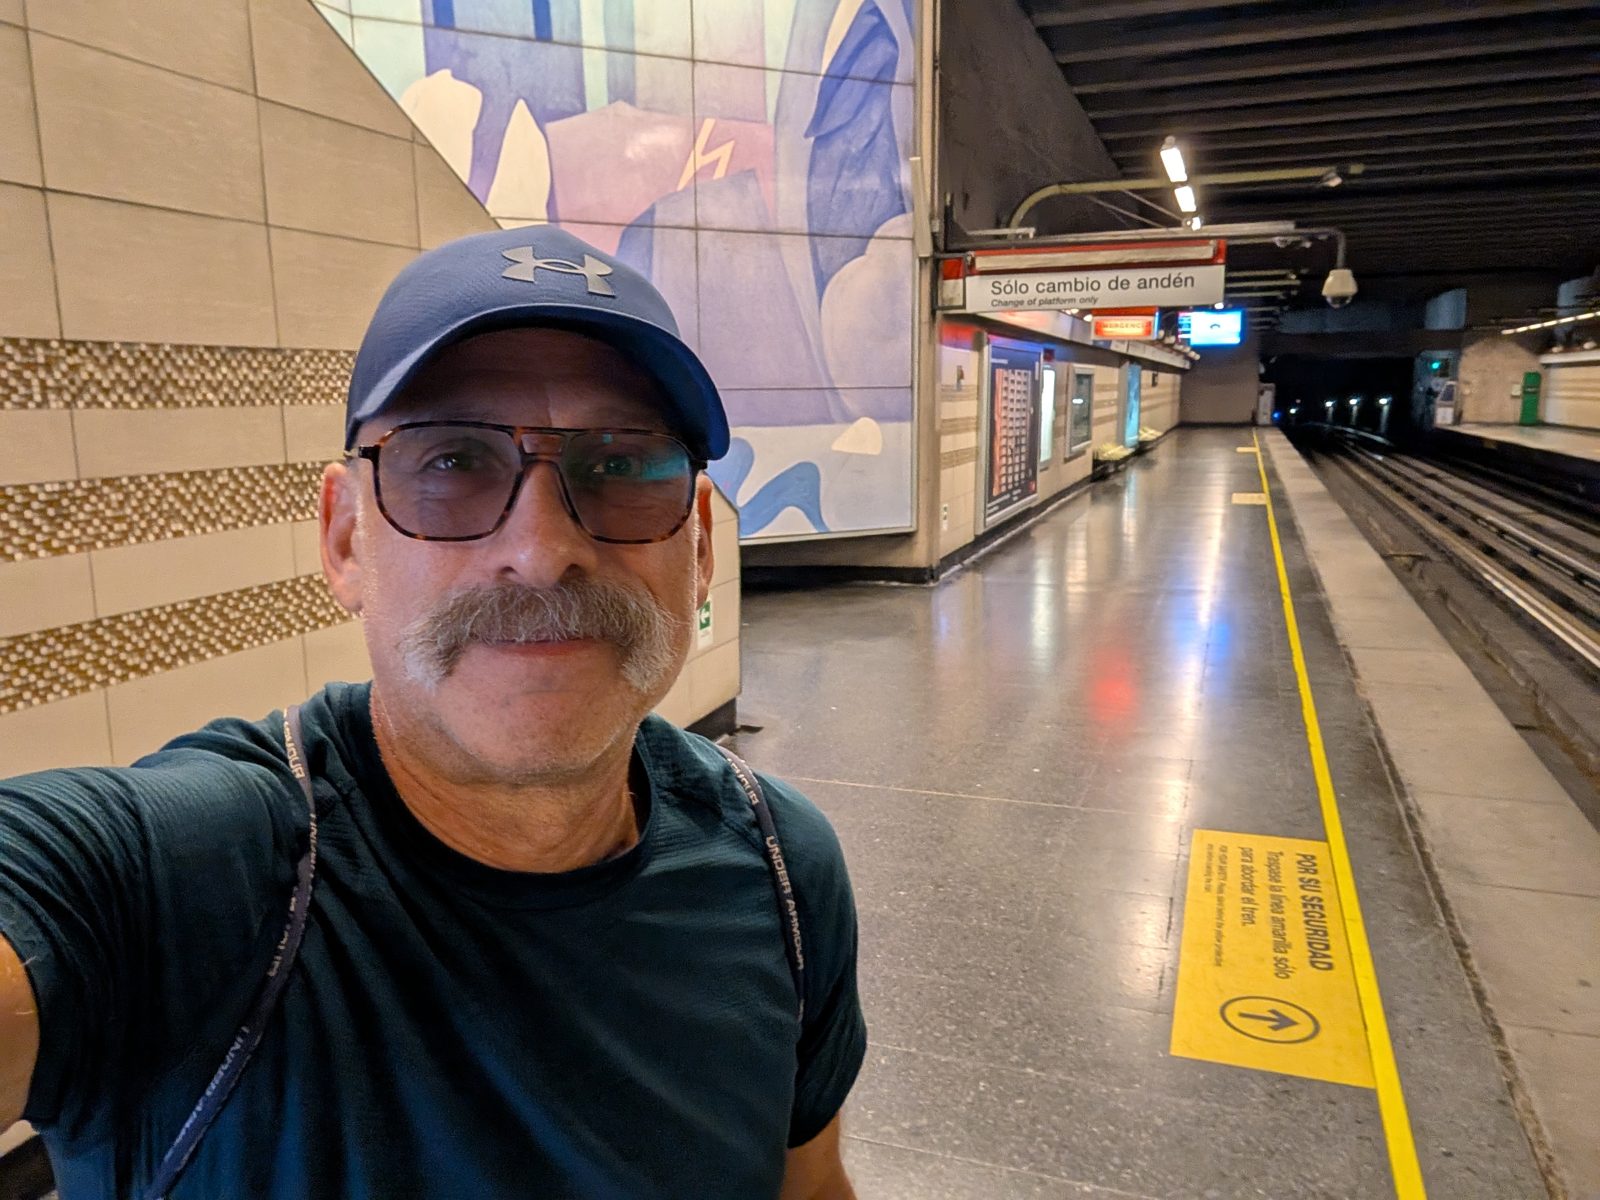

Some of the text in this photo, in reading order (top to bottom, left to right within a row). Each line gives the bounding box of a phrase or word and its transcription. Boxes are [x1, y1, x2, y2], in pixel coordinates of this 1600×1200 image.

[991, 272, 1195, 295] Sólo cambio de andén
[991, 299, 1025, 307] Change
[1038, 297, 1076, 306] platform
[1079, 296, 1099, 304] only
[765, 835, 793, 894] UNDER
[1238, 846, 1253, 863] para
[1264, 850, 1284, 883] Traspase
[1241, 864, 1257, 895] abordar
[1270, 885, 1284, 893] la
[1242, 897, 1258, 905] el
[1296, 853, 1333, 971] POR SU SEGURIDAD
[1271, 916, 1291, 954] amarilla
[1274, 957, 1295, 980] sólo
